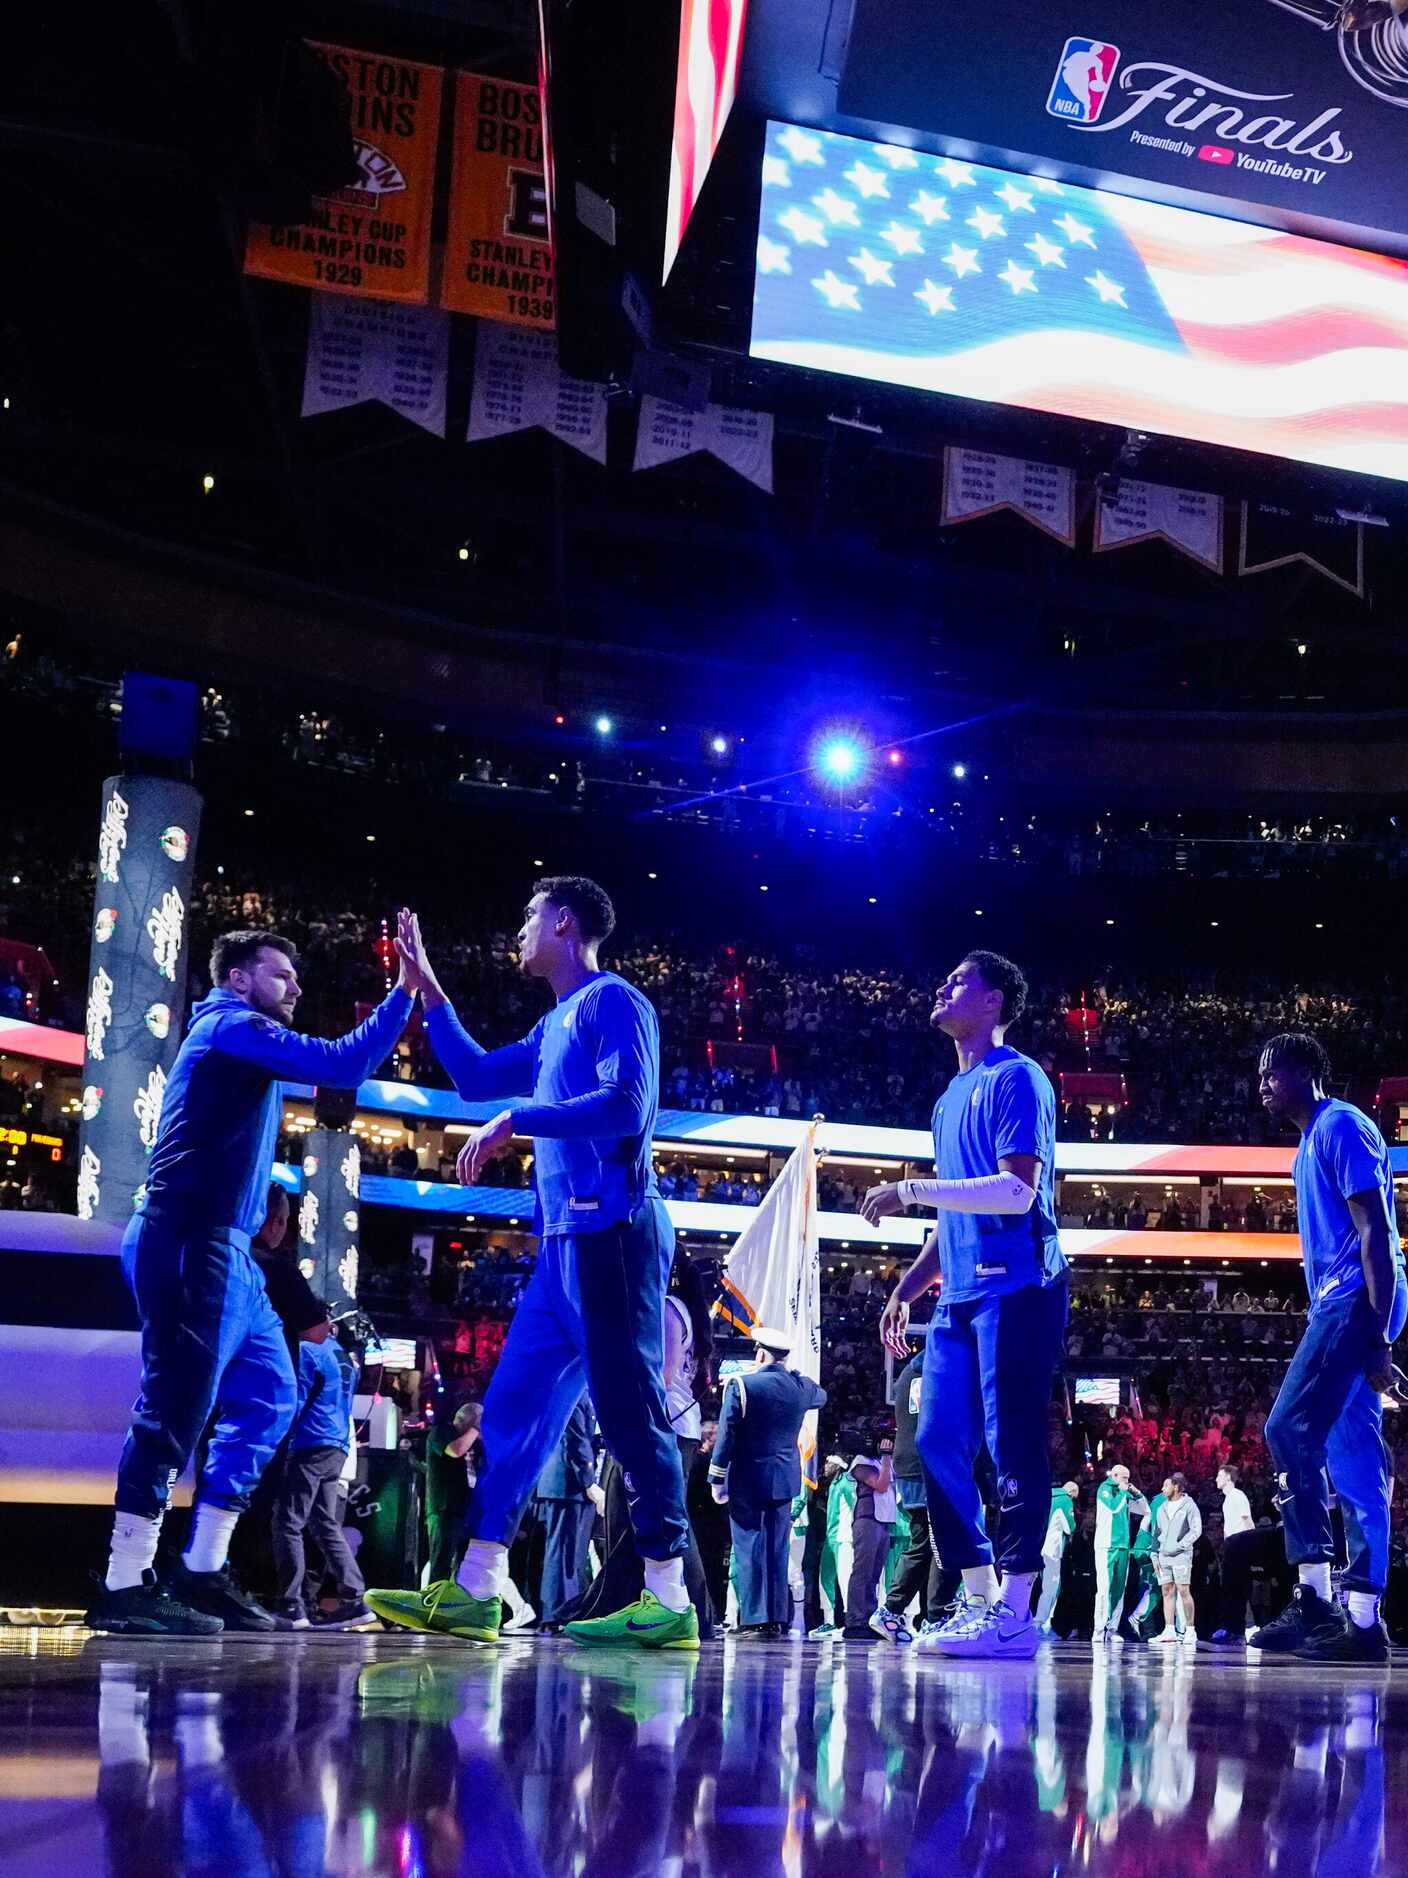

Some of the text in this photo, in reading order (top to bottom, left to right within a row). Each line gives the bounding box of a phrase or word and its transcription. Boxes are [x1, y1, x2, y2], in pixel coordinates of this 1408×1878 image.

[1054, 98, 1080, 116] NBA
[1067, 62, 1352, 163] Finals
[1130, 130, 1183, 152] Presented
[1183, 143, 1197, 157] by
[270, 228, 406, 269] CHAMPIONS
[314, 259, 362, 287] 1929
[507, 294, 552, 320] 1939
